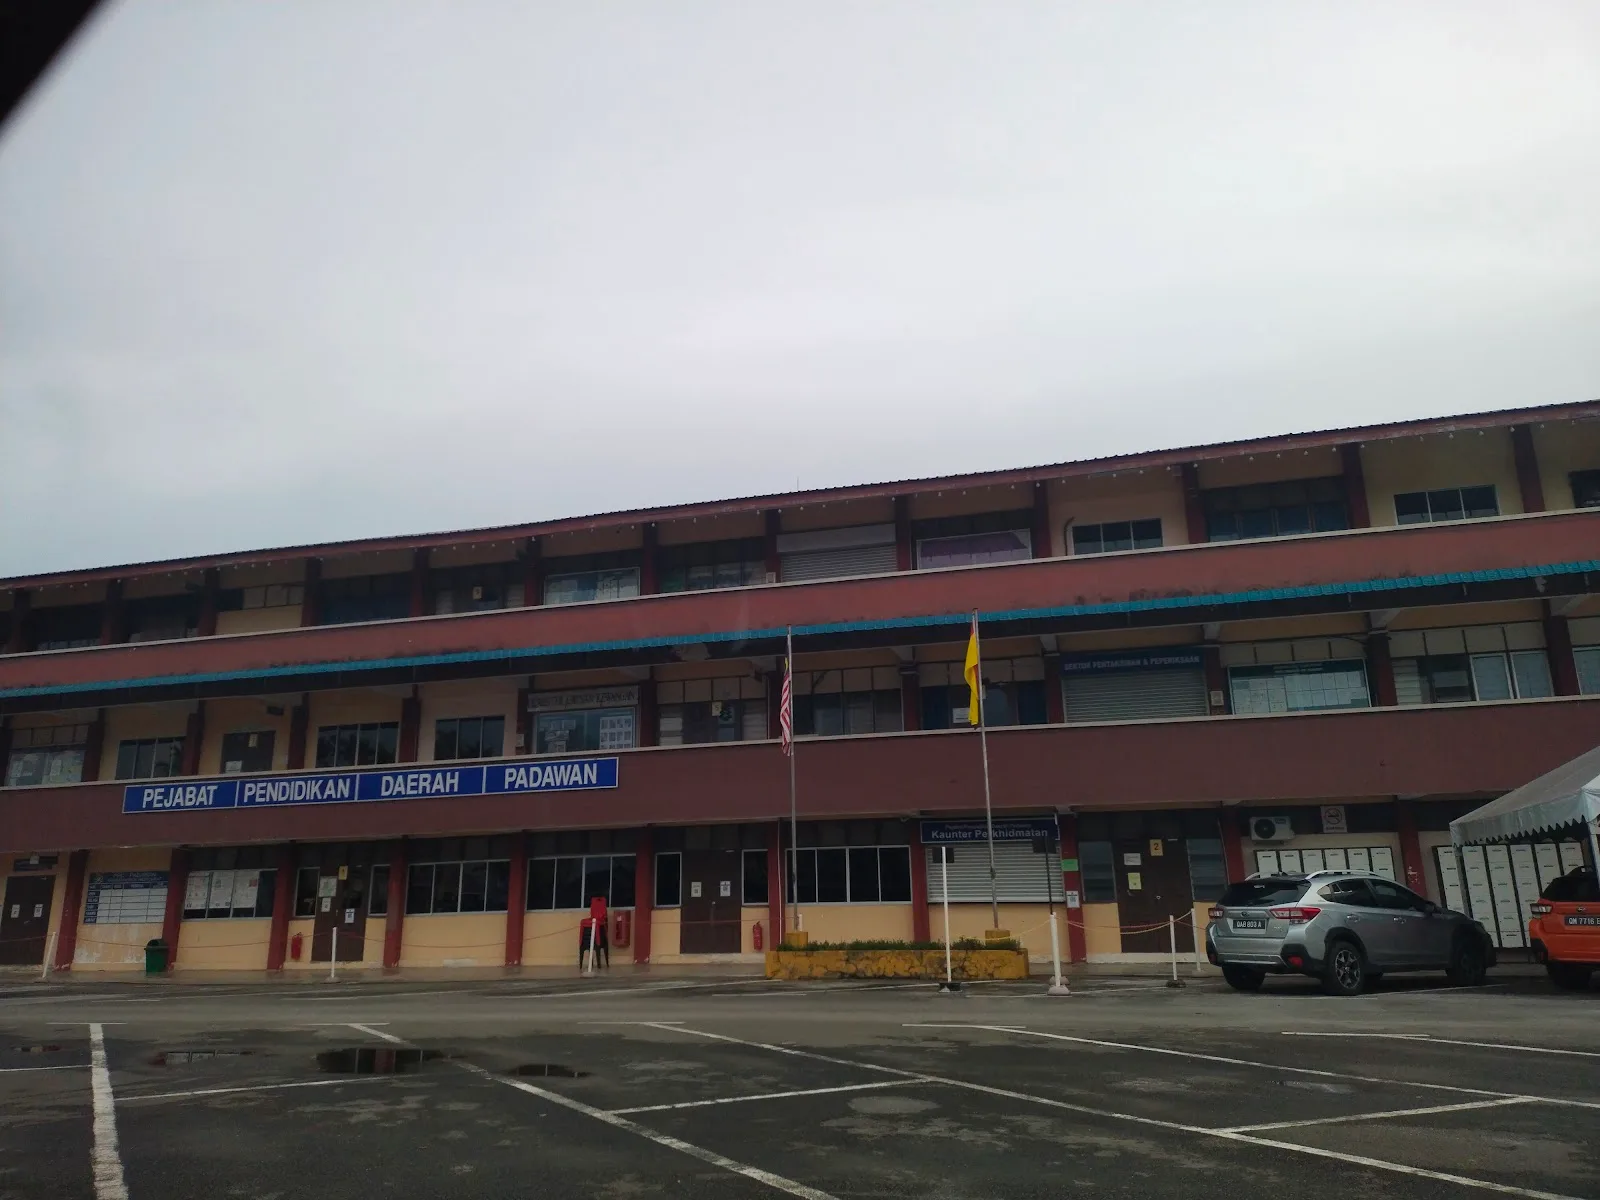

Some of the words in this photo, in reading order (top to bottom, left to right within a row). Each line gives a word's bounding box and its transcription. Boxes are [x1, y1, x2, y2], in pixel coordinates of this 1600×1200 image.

[142, 785, 218, 809] PEJABAT
[244, 779, 350, 803] PENDIDIKAN
[381, 771, 460, 796] DAERAH
[504, 763, 598, 789] PADAWAN
[931, 830, 972, 839] Kaunter
[974, 828, 1048, 838] Pekhidmatan
[1153, 843, 1159, 851] 2
[1579, 917, 1595, 925] 7716
